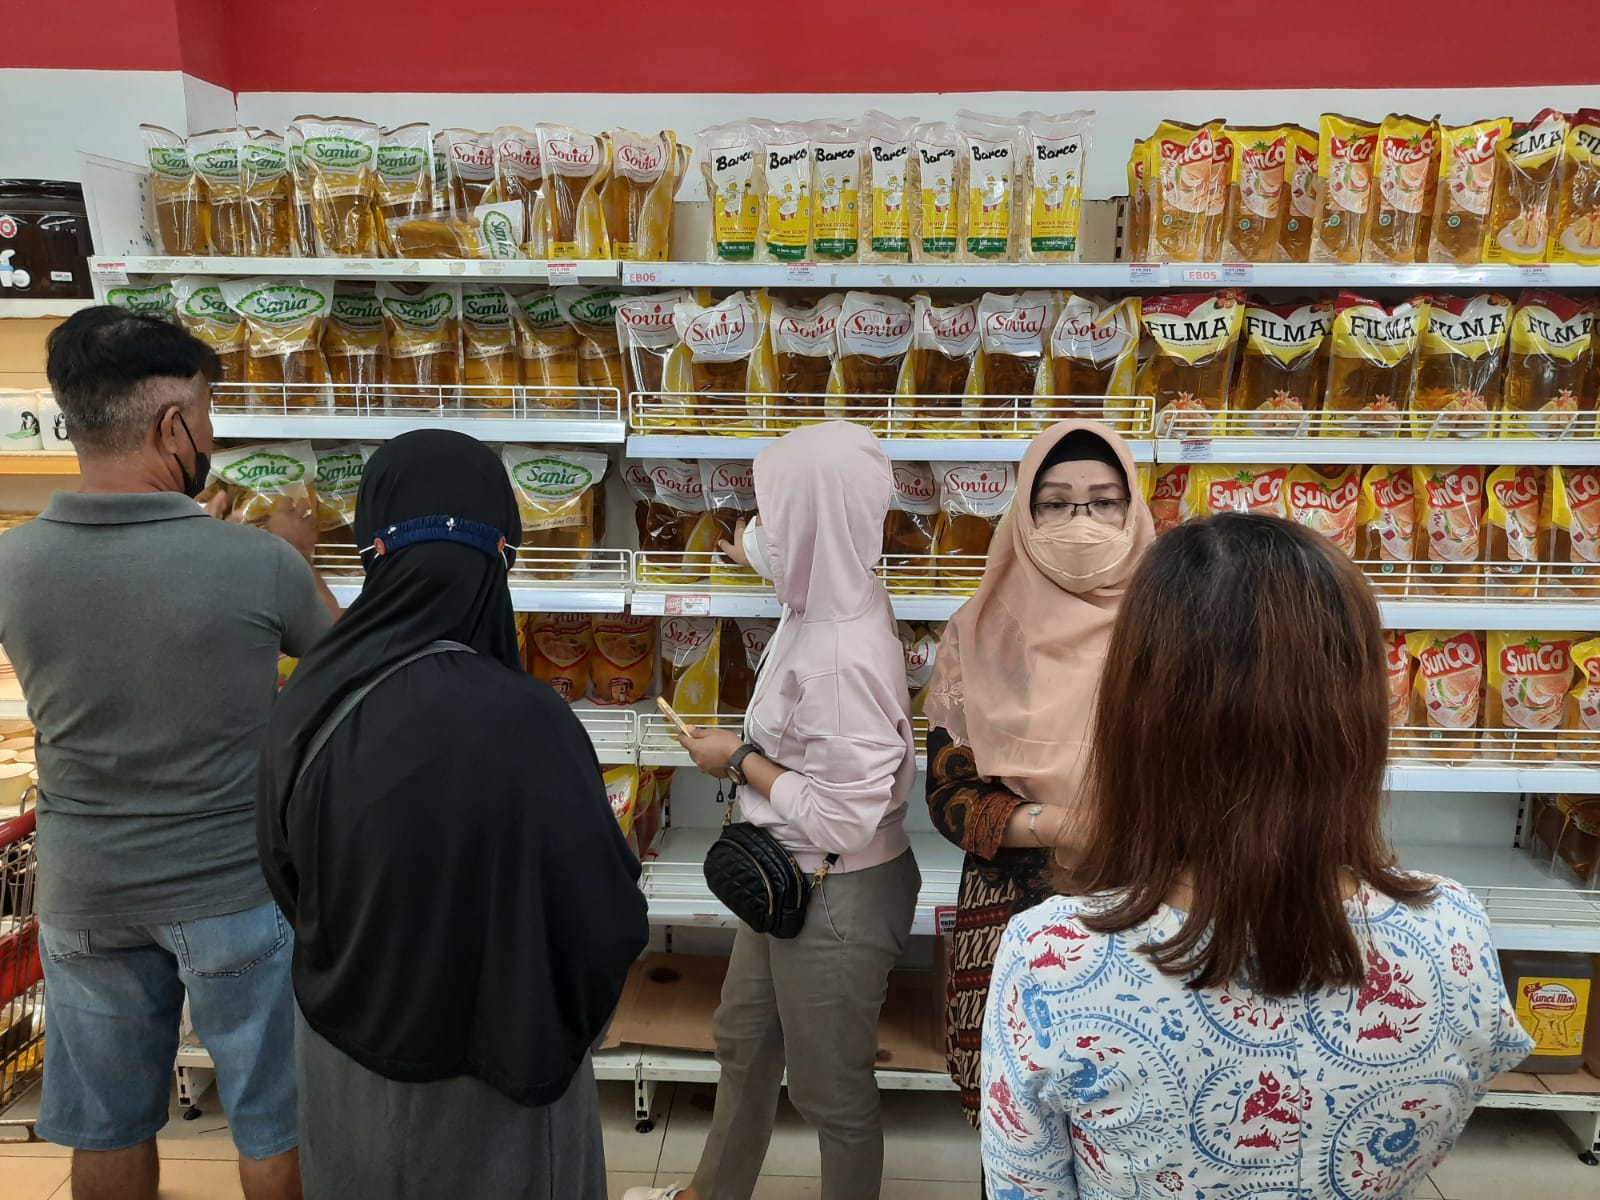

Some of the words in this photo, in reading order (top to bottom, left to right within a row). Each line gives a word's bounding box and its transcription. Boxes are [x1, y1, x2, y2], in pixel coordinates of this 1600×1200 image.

[158, 153, 189, 169] Sani
[315, 144, 361, 160] Sania
[378, 152, 417, 170] Sania
[547, 142, 588, 163] Sovia
[621, 148, 658, 169] Sovia
[770, 148, 808, 170] Barco
[815, 147, 856, 162] Barco
[921, 148, 956, 164] Barco
[972, 145, 1009, 160] Barco
[1037, 143, 1077, 160] Barco
[205, 156, 239, 169] Sani
[491, 221, 510, 256] Sania
[630, 272, 657, 283] EB06
[1189, 271, 1217, 280] EB05
[254, 294, 308, 314] Sania
[397, 302, 441, 319] Sania
[620, 304, 674, 326] Sovia
[994, 311, 1041, 333] Sovia
[692, 313, 741, 341] Sovia
[788, 316, 837, 338] Sovia
[852, 316, 905, 337] Sovia
[1145, 317, 1229, 342] FILMA
[1246, 316, 1333, 342] FILMA
[1349, 316, 1418, 341] FILMA
[1427, 314, 1506, 341] FILMA
[235, 461, 287, 482] Sania
[316, 460, 363, 483] Sania
[527, 466, 579, 485] Sania
[656, 468, 704, 494] Sovia
[718, 468, 752, 487] Sovi
[949, 473, 1001, 493] Sovia
[1293, 482, 1358, 508] SunCo
[1421, 642, 1476, 676] SunCo
[1506, 645, 1562, 672] SunCo
